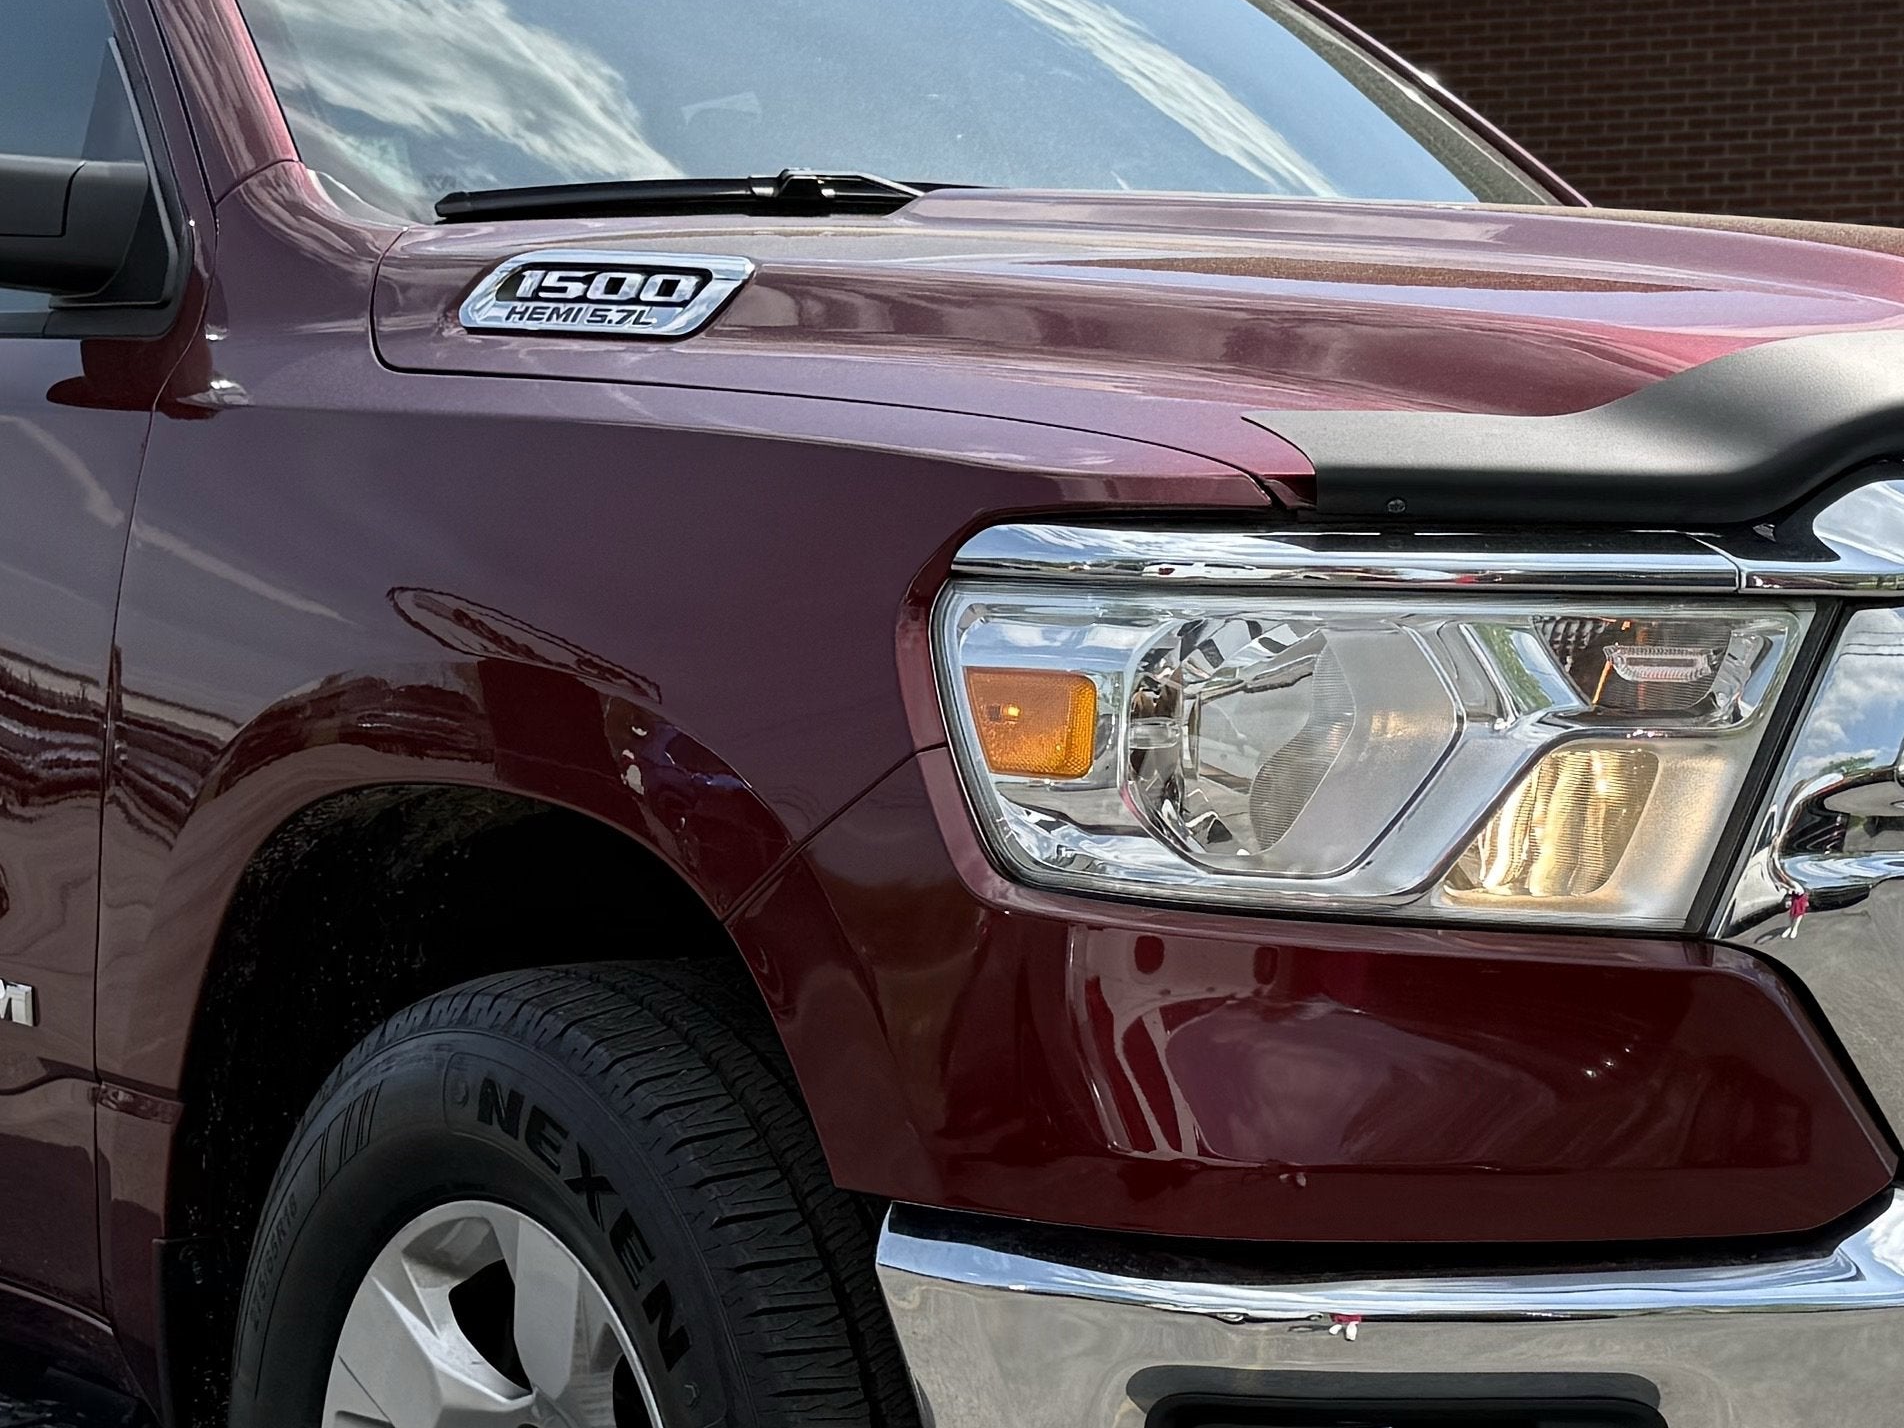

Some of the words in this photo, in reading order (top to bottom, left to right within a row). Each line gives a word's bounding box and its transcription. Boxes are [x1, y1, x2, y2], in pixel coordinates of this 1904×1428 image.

[514, 269, 700, 303] 1500
[505, 304, 582, 324] HEMI
[586, 305, 654, 327] 5.7L
[477, 1077, 693, 1369] NEXEN
